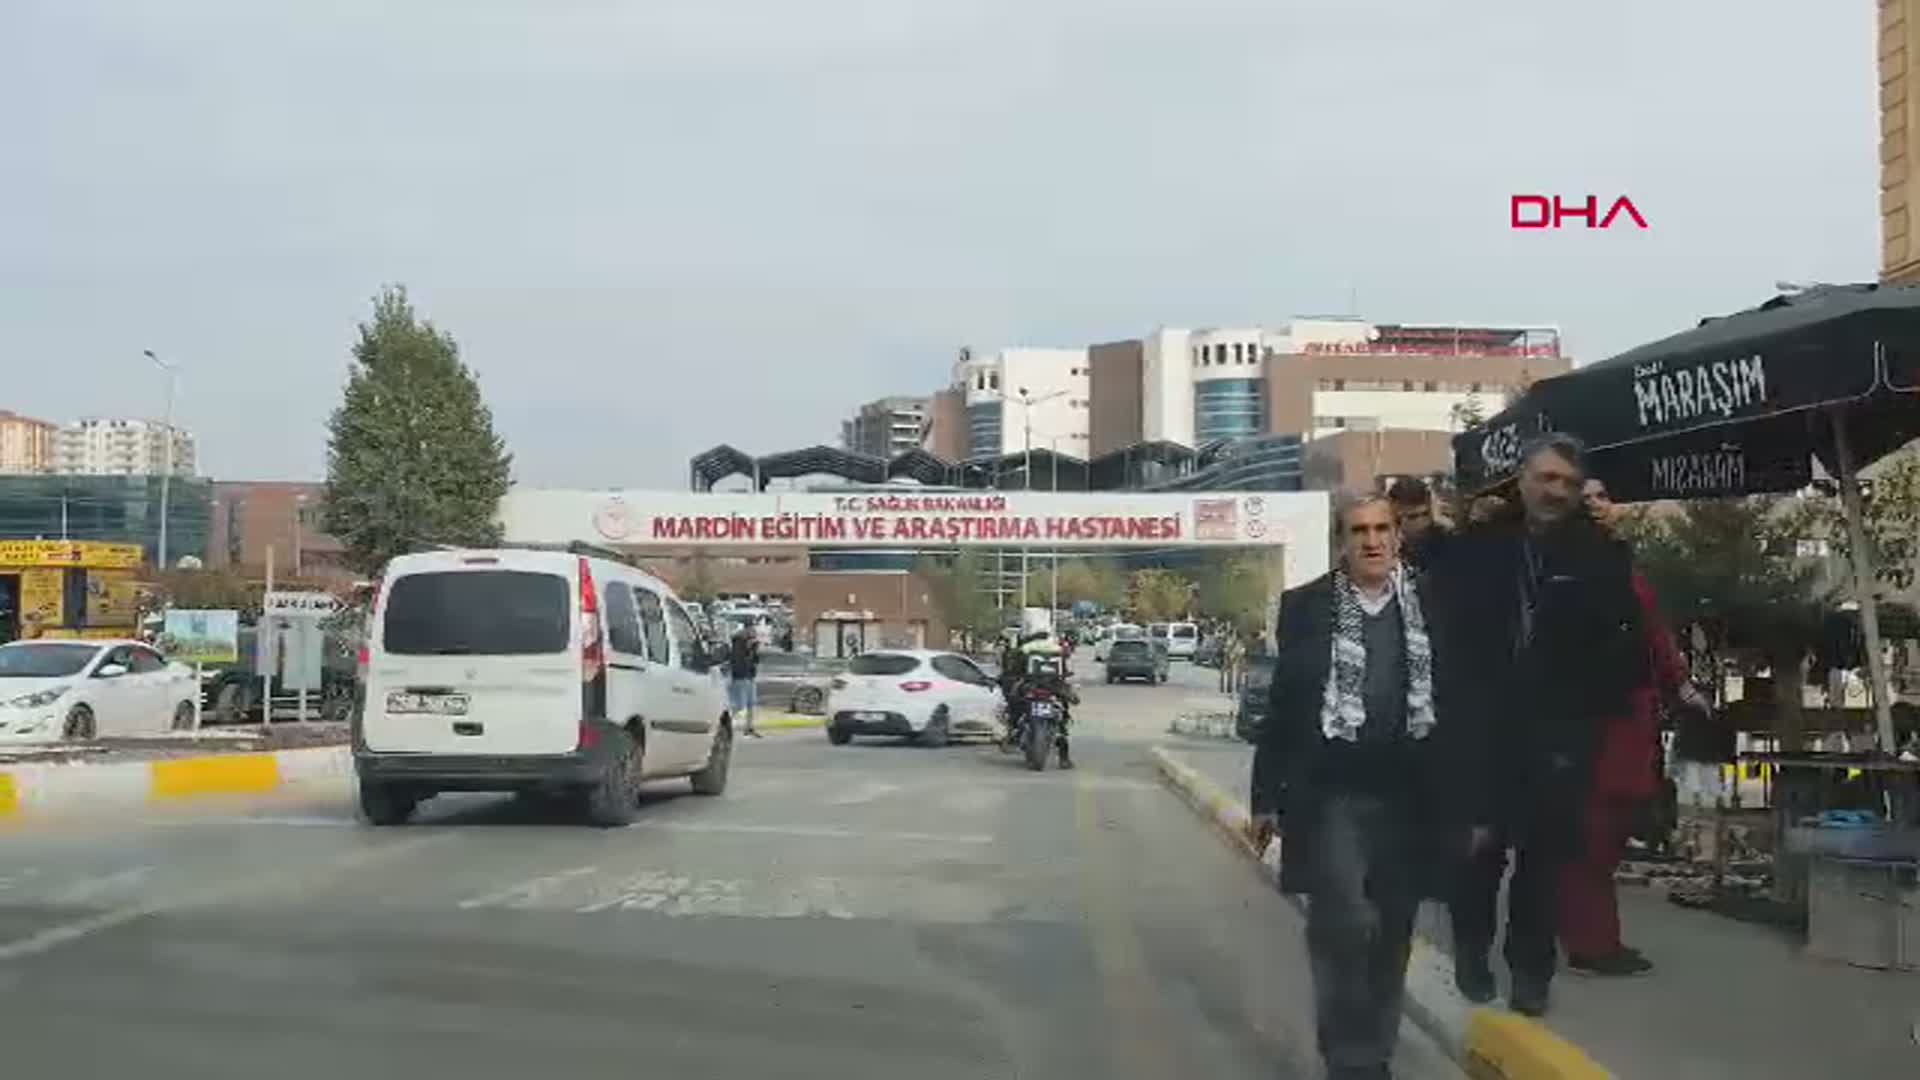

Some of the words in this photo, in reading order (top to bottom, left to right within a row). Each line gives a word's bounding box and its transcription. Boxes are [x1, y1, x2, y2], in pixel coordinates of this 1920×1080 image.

[1634, 354, 1767, 426] MARAŞIM
[866, 495, 919, 511] SAĞLIK
[922, 494, 1006, 511] BAKANLIĞI
[653, 513, 755, 539] MARDİN
[761, 511, 846, 539] EĞİTİM
[852, 517, 886, 538] VE
[893, 516, 1041, 543] ARAŞTIRMA
[1045, 514, 1181, 539] HASTANESİ
